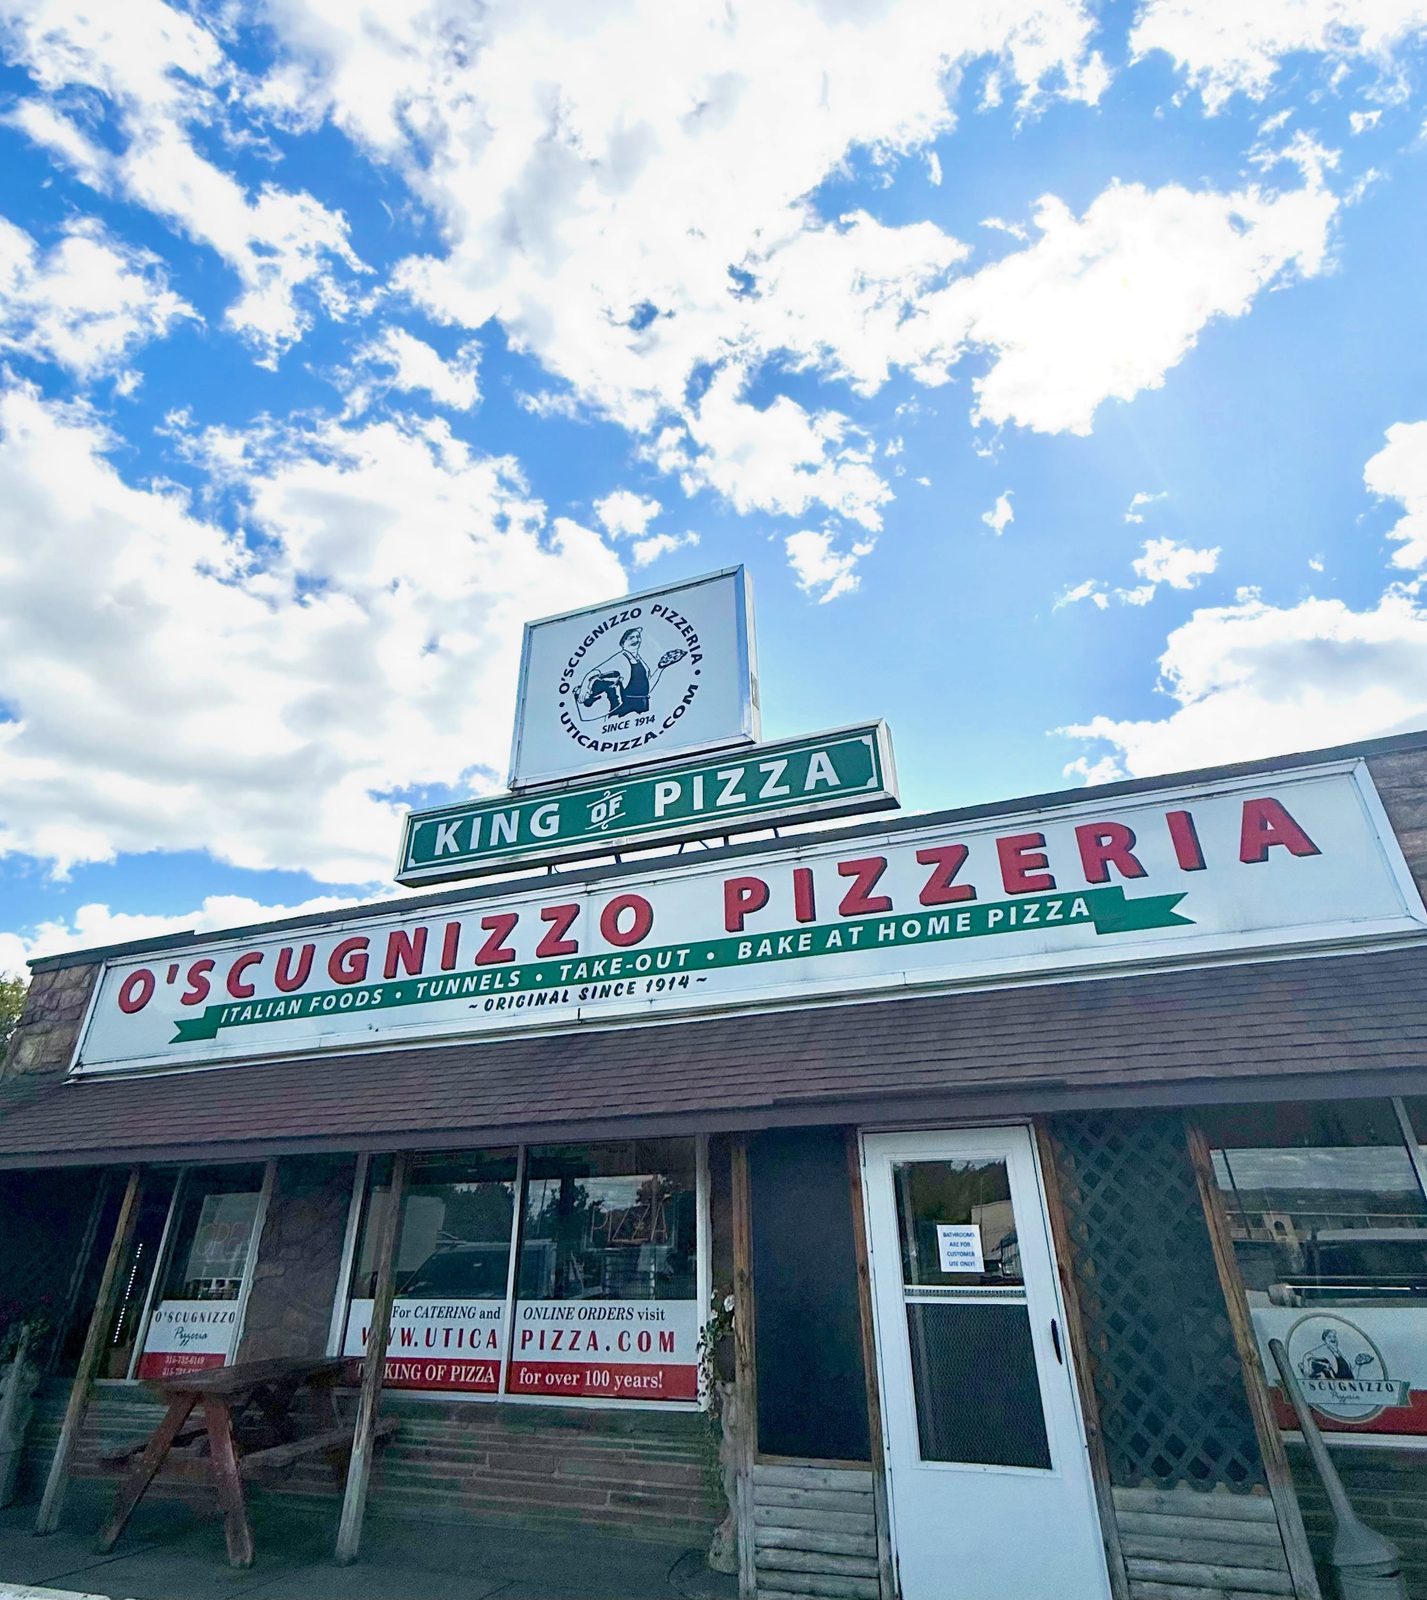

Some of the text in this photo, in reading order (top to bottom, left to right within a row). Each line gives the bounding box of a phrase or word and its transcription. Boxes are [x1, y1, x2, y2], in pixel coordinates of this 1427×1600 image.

[559, 603, 703, 695] O'SCUGNIZZO PIZZERIA
[560, 684, 699, 752] UTICAPIZZA.COM
[602, 714, 656, 734] SINCE 1914
[434, 751, 840, 856] KING OF PIZZA
[117, 796, 1322, 1015] O'SCUGNIZZO PIZZERIA
[220, 897, 1091, 1024] ITALIAN FOODS TUNNELS TAKE-OUT BAKE AT HOME PIZZA
[578, 981, 637, 1001] SINCE
[155, 1311, 236, 1323] O'SCUGNIZZO
[392, 1306, 666, 1321] For CATERING and ONLINE ORDERS visit
[520, 1328, 676, 1353] PIZZA.COM
[383, 1363, 421, 1381] KING
[424, 1365, 446, 1382] OF
[450, 1365, 495, 1384] PIZZA
[519, 1369, 542, 1385] for
[545, 1374, 579, 1387] over
[584, 1370, 610, 1387] 100
[613, 1370, 663, 1392] years!
[1302, 1381, 1394, 1393] 'SCUGNIZZO
